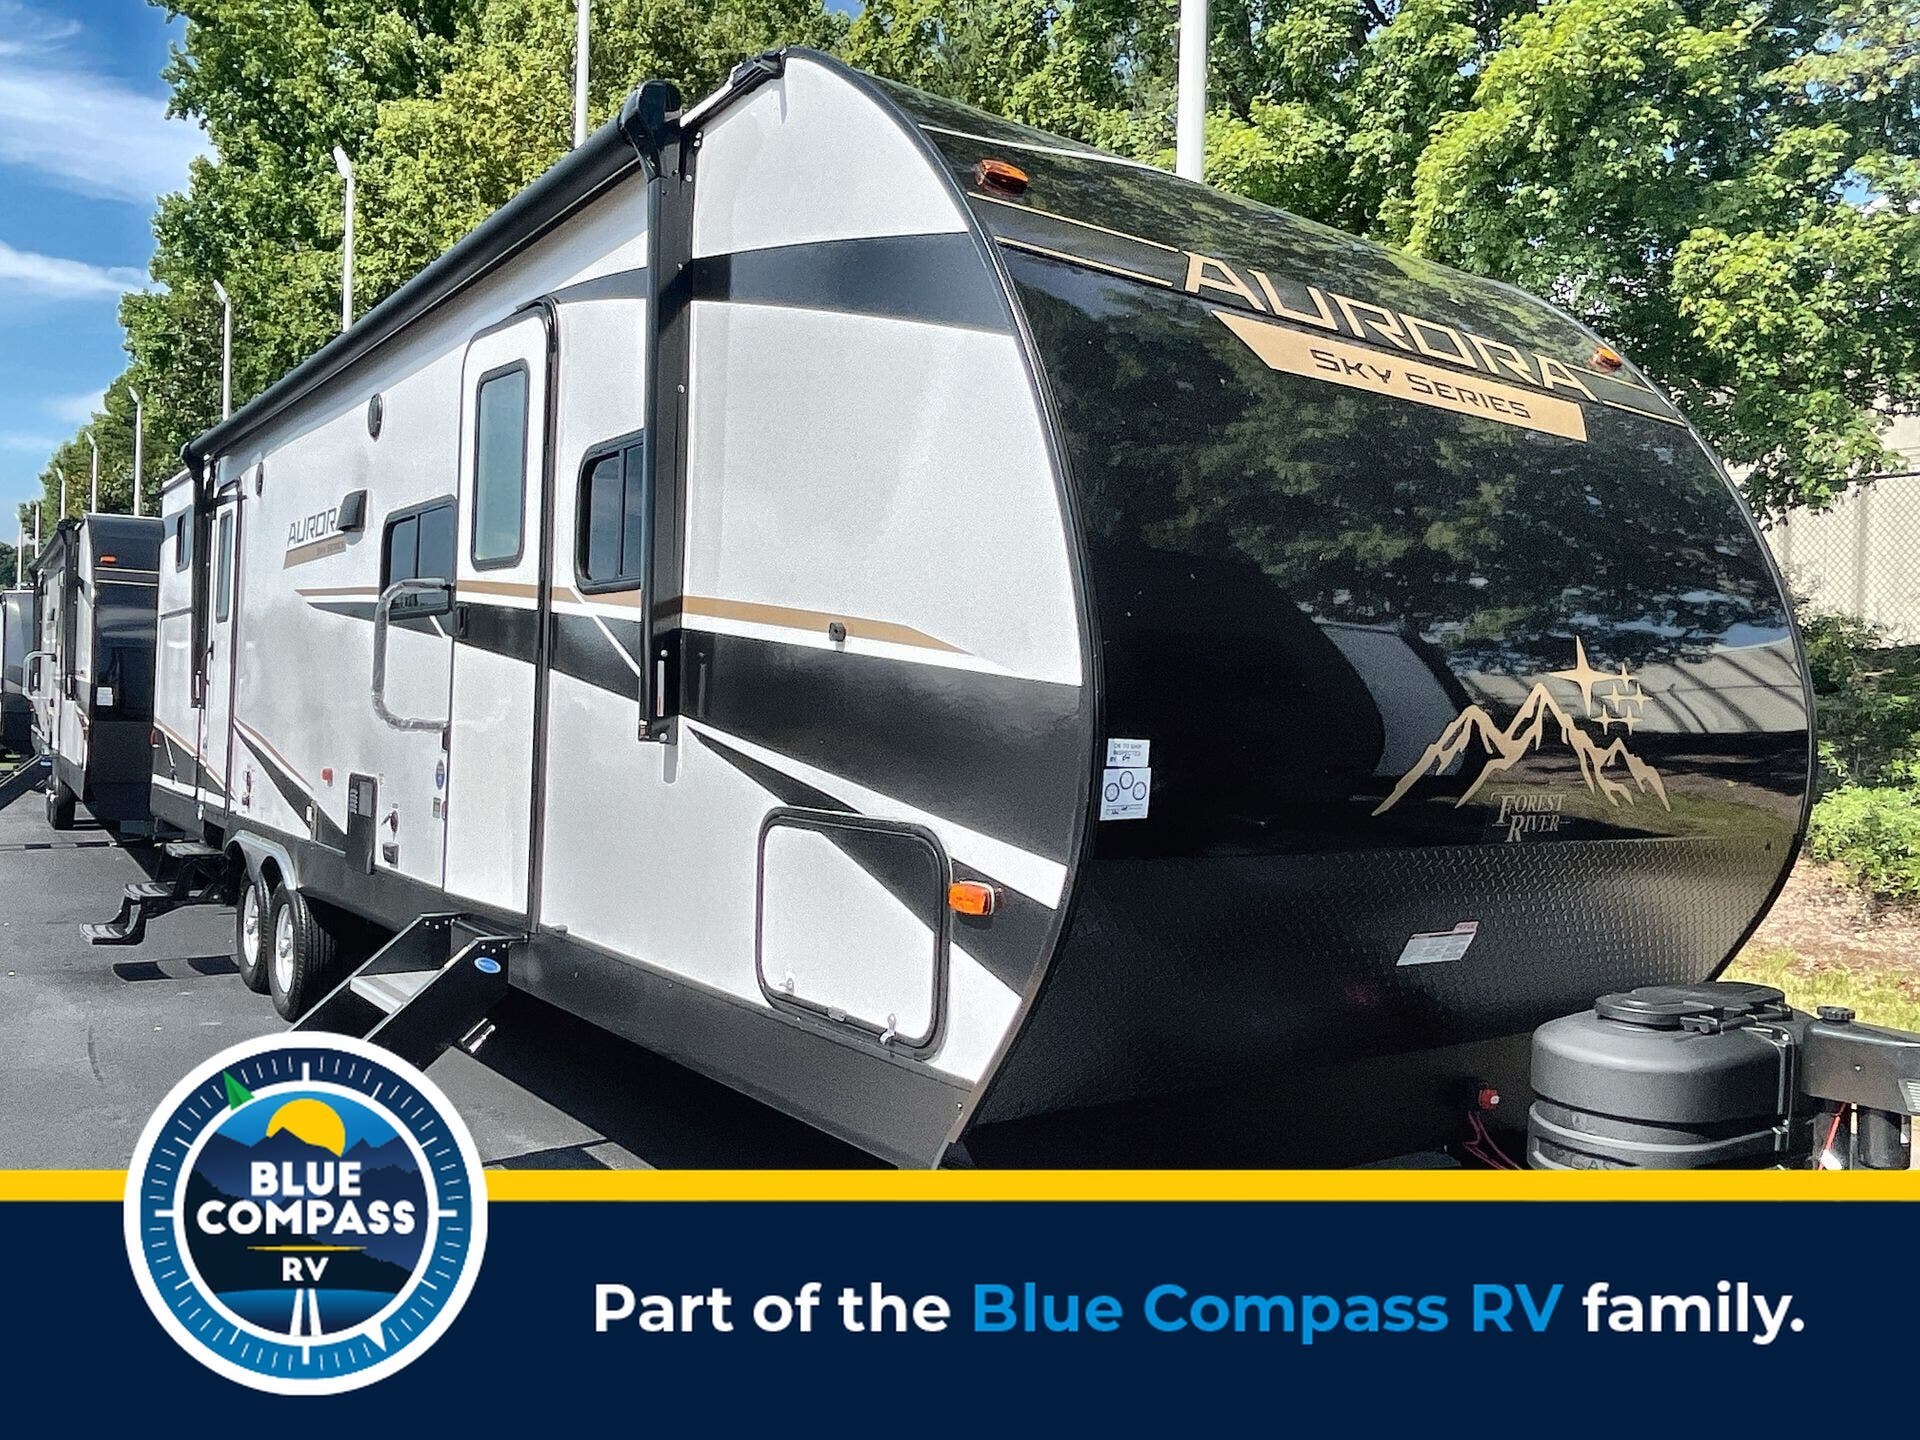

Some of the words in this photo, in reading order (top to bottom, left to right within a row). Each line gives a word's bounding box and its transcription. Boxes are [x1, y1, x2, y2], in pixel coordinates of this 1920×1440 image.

[1182, 250, 1598, 402] AURORA
[1310, 349, 1392, 384] SKY
[1404, 372, 1532, 419] SERIES
[286, 507, 339, 547] AUROR
[1496, 793, 1567, 824] FOREST
[1504, 814, 1561, 842] RIVER
